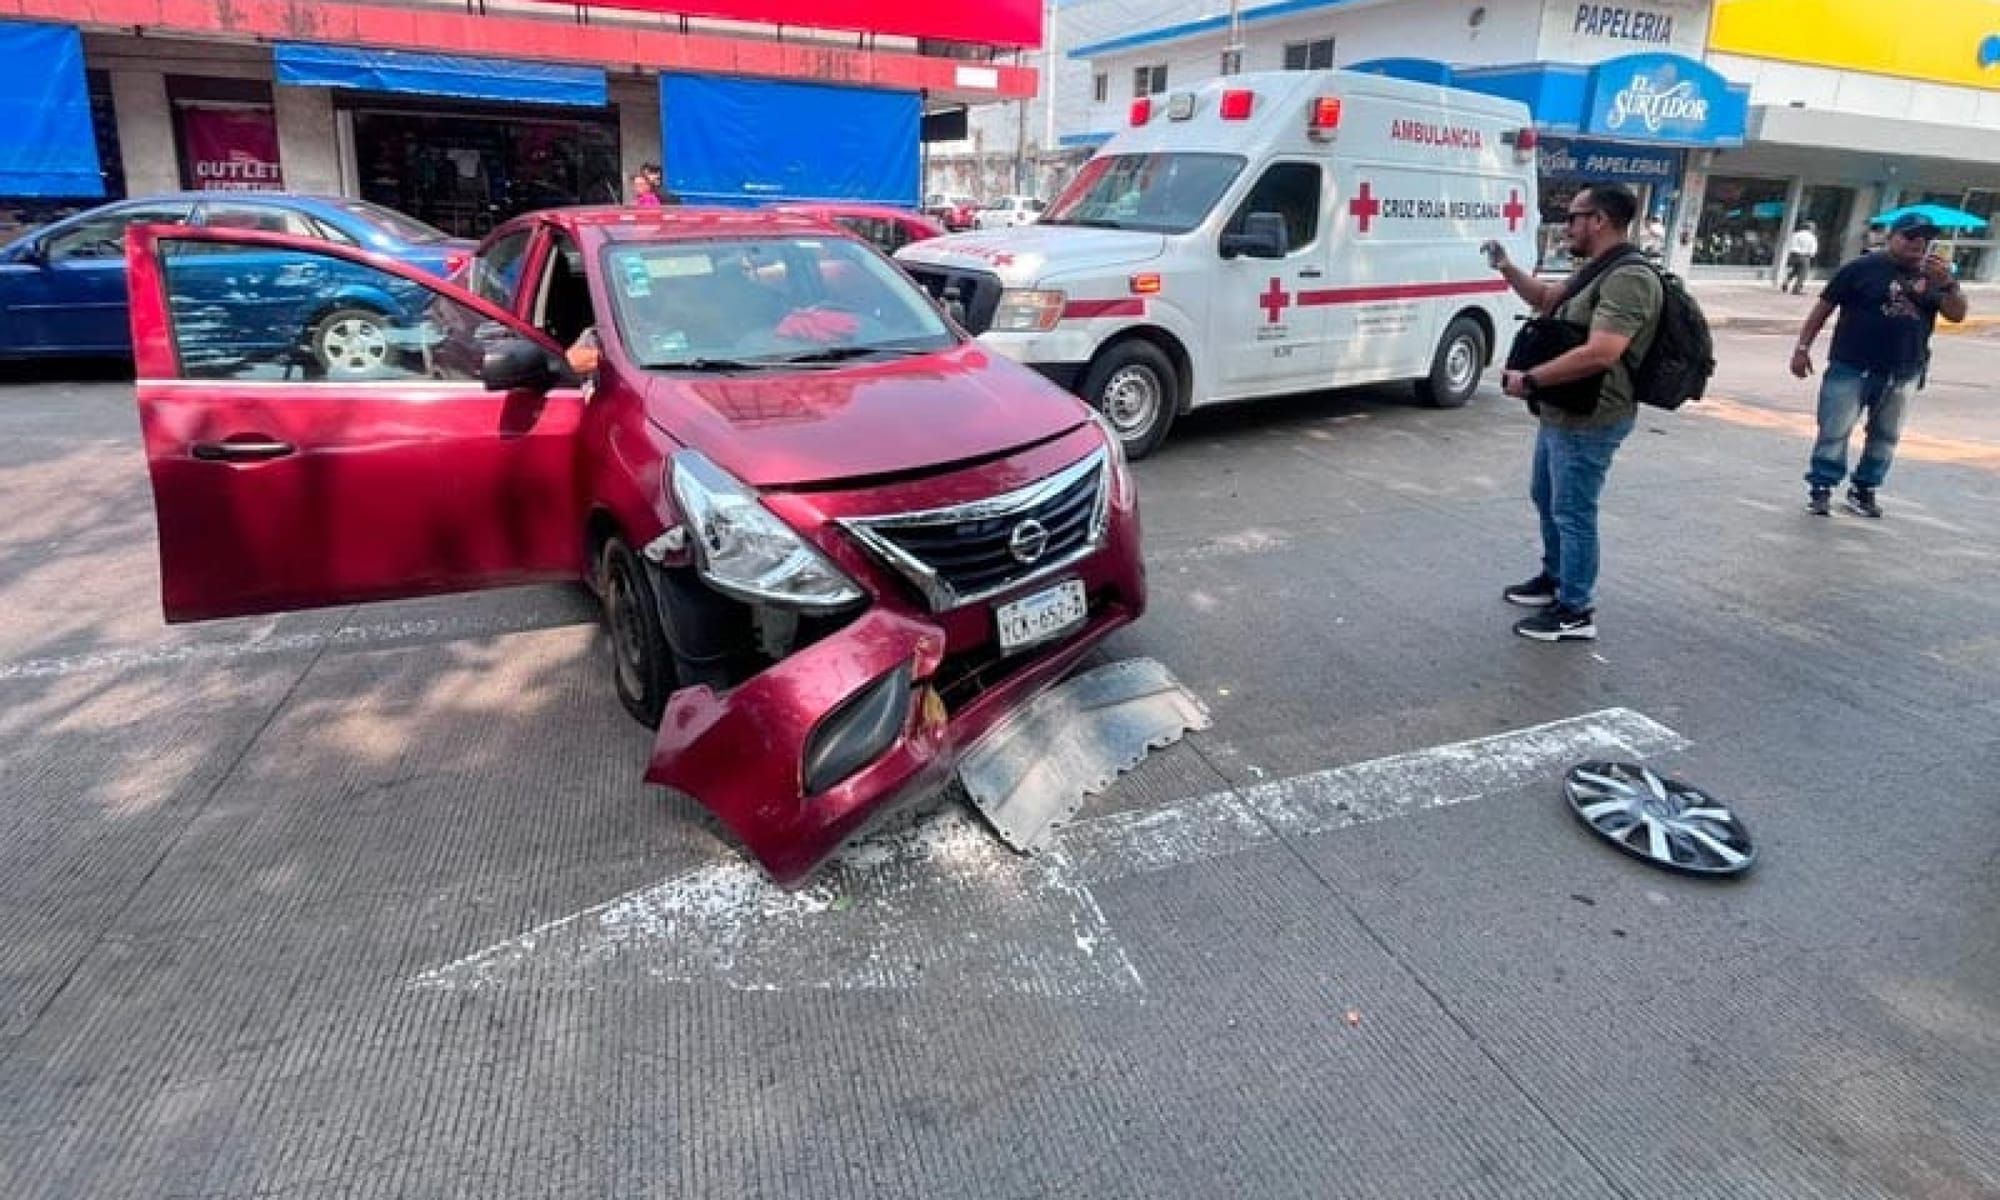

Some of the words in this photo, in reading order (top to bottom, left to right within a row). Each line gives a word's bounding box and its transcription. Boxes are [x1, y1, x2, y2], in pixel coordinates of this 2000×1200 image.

[1574, 4, 1672, 43] PAPELERIA
[1631, 74, 1655, 95] EL
[1391, 119, 1482, 149] AMBULANCIA
[197, 160, 280, 178] OUTLET
[1382, 199, 1415, 218] CRUZ
[1417, 199, 1446, 218] ROJA
[1450, 201, 1501, 220] MEXICANA
